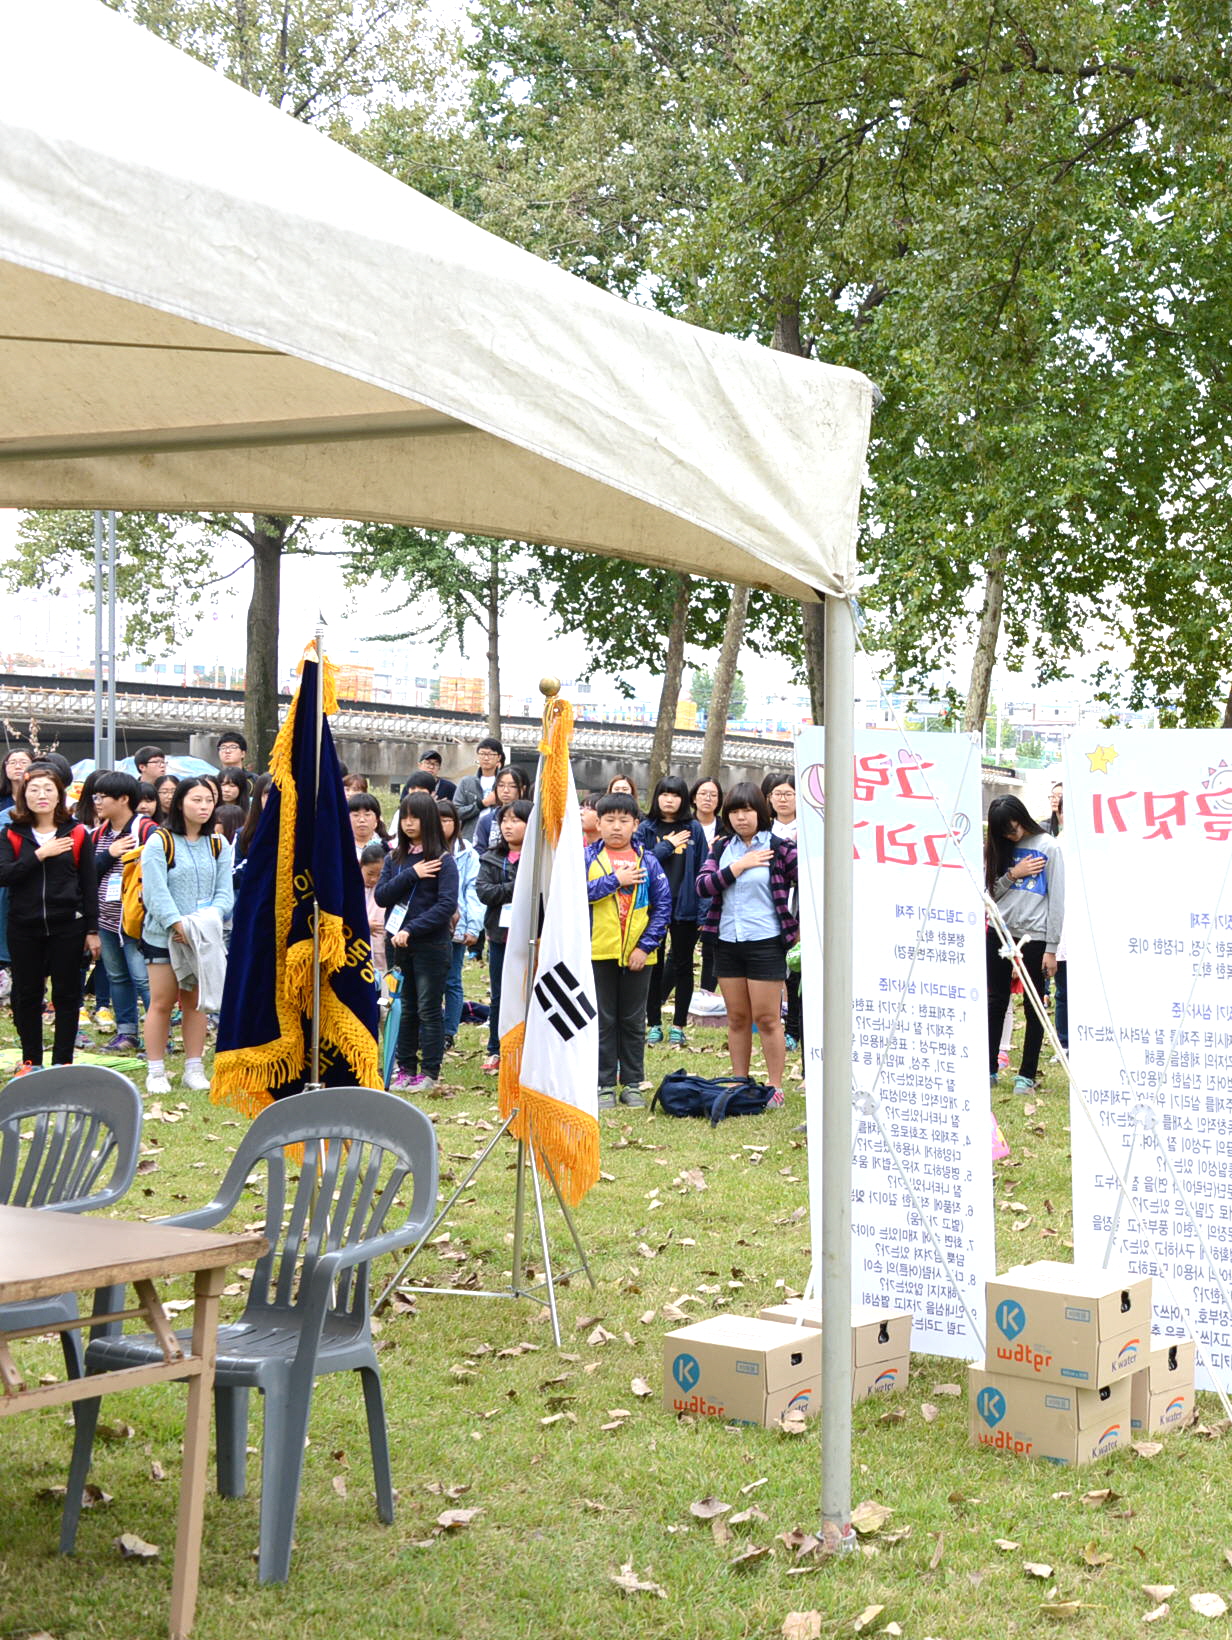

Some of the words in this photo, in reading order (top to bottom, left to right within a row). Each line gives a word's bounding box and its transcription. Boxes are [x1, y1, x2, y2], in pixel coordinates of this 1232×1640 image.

[1001, 1304, 1019, 1332] K
[678, 1359, 694, 1383] K
[1112, 1361, 1117, 1373] K
[1118, 1354, 1137, 1369] water
[984, 1393, 1000, 1417] K
[1166, 1411, 1182, 1423] water
[1099, 1440, 1117, 1455] water
